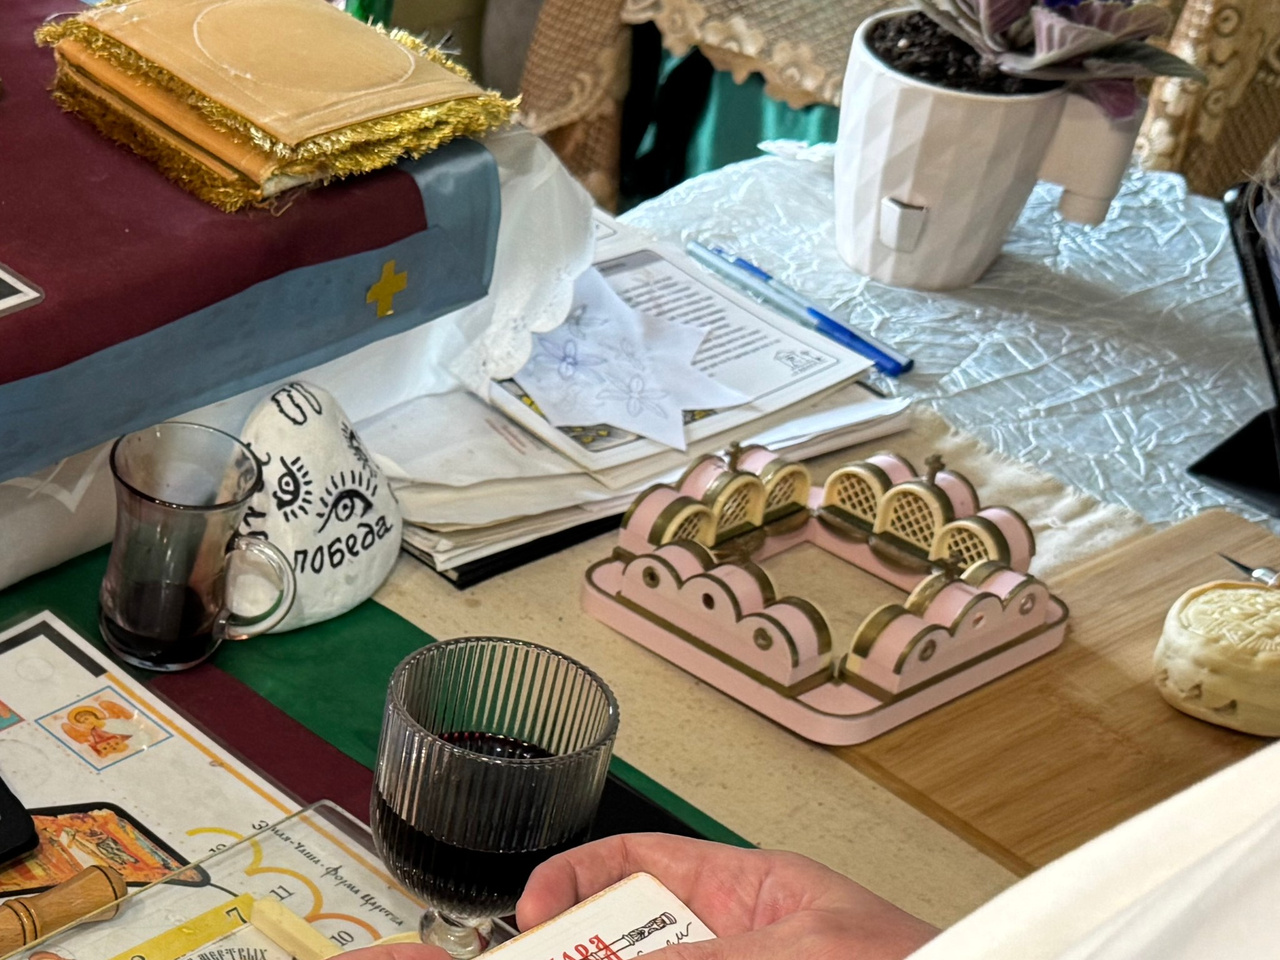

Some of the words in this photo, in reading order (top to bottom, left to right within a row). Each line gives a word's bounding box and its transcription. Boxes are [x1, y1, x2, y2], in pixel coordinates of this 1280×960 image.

[294, 515, 393, 575] победа
[269, 885, 295, 902] 11
[225, 906, 248, 924] 7
[330, 930, 355, 947] 10
